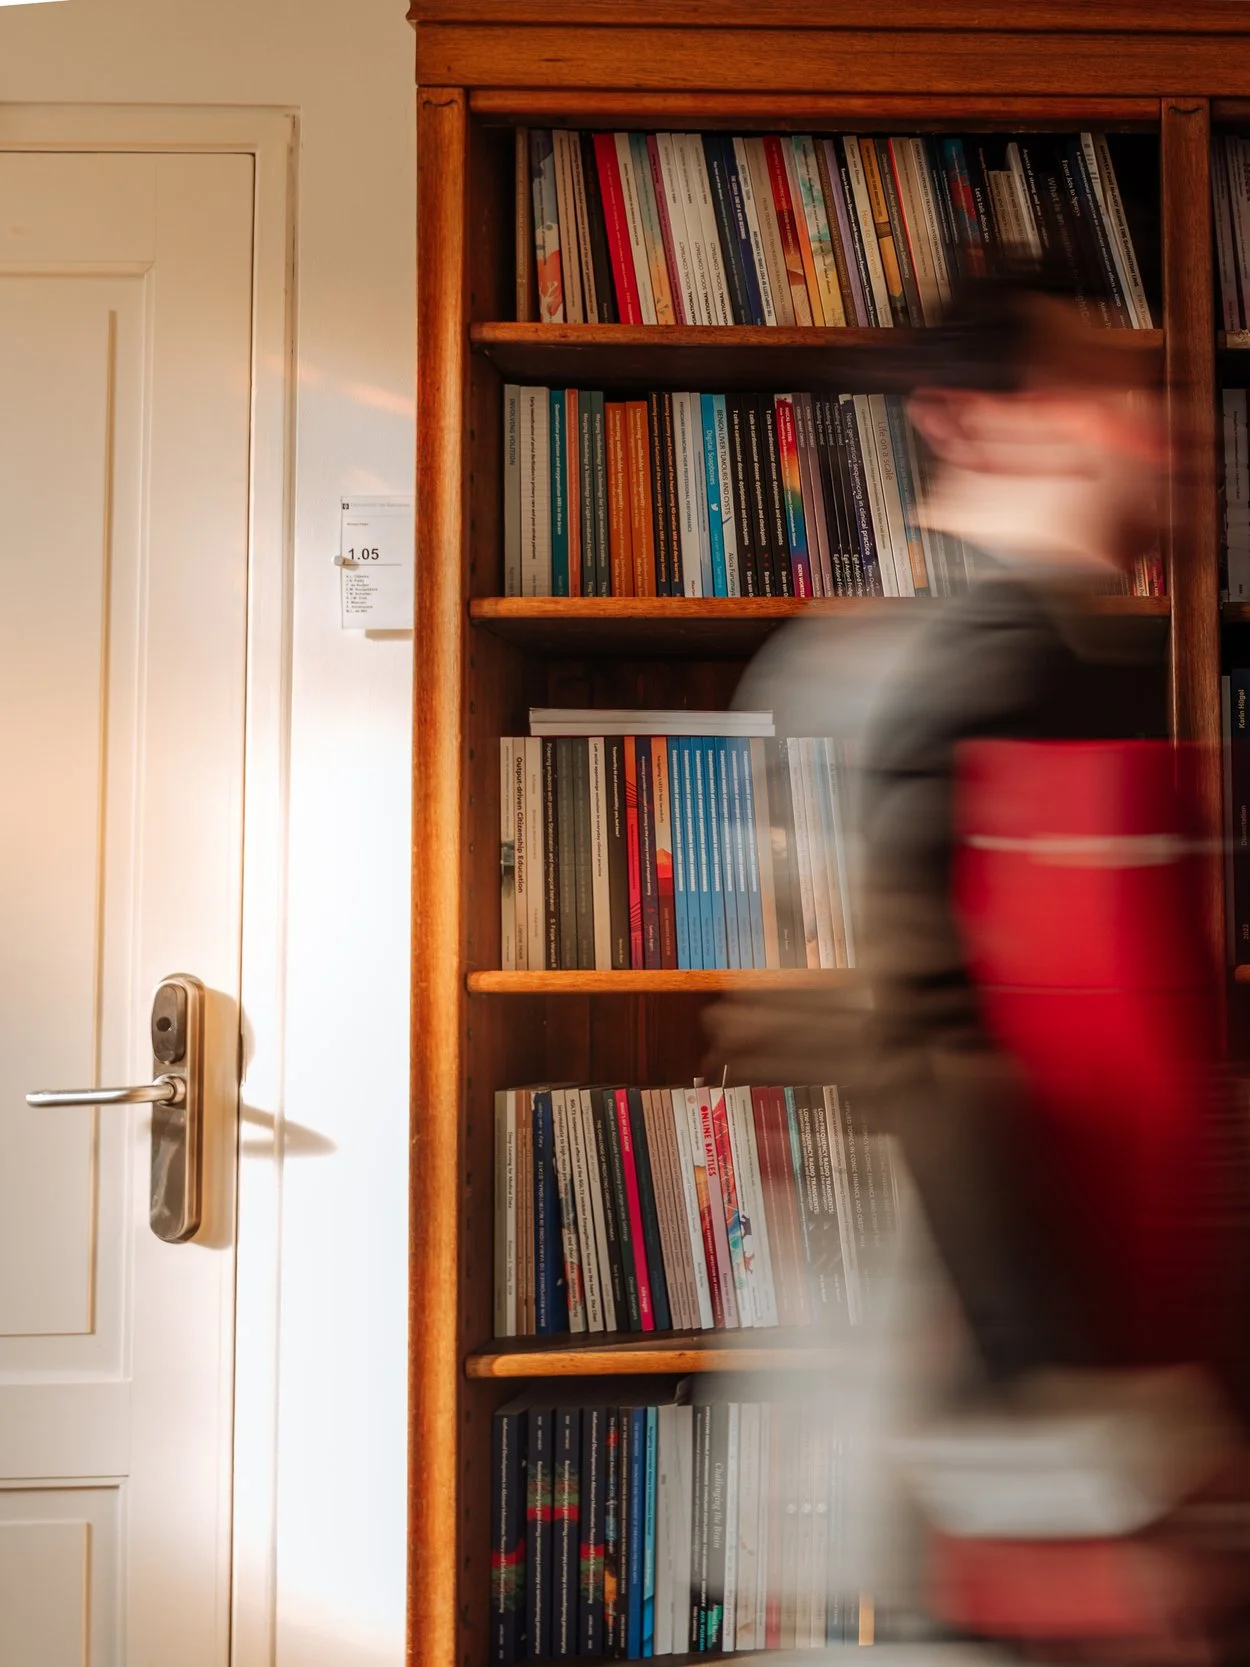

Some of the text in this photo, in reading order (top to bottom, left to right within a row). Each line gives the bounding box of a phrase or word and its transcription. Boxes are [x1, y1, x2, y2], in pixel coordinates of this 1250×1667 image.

[1061, 159, 1071, 176] From
[1065, 176, 1074, 188] Jets
[974, 187, 982, 201] Let's
[980, 213, 988, 231] about
[1071, 195, 1082, 216] Sprays
[679, 241, 687, 270] CONTRACT
[695, 241, 703, 270] CONTRACT
[710, 242, 719, 270] CONTRACT
[860, 209, 870, 226] How
[866, 240, 881, 279] Intervene?
[716, 409, 724, 431] BENIGN
[845, 413, 853, 427] Next
[718, 432, 726, 449] LIVER
[847, 428, 857, 462] generation
[876, 421, 887, 437] Life
[882, 458, 894, 480] scale
[705, 429, 716, 485] Digital Soapboxes
[720, 451, 728, 480] TUMOURS
[852, 463, 862, 499] sequencing
[723, 495, 731, 515] CYSTS
[858, 507, 867, 529] clinical
[348, 548, 379, 560] 1.05
[861, 530, 870, 555] practice
[699, 1105, 716, 1176] ONLINE BATTLES
[802, 1108, 813, 1156] LOW-FREQUENCY
[807, 1157, 815, 1176] RADIO
[713, 1462, 722, 1547] Challenging the Brain
